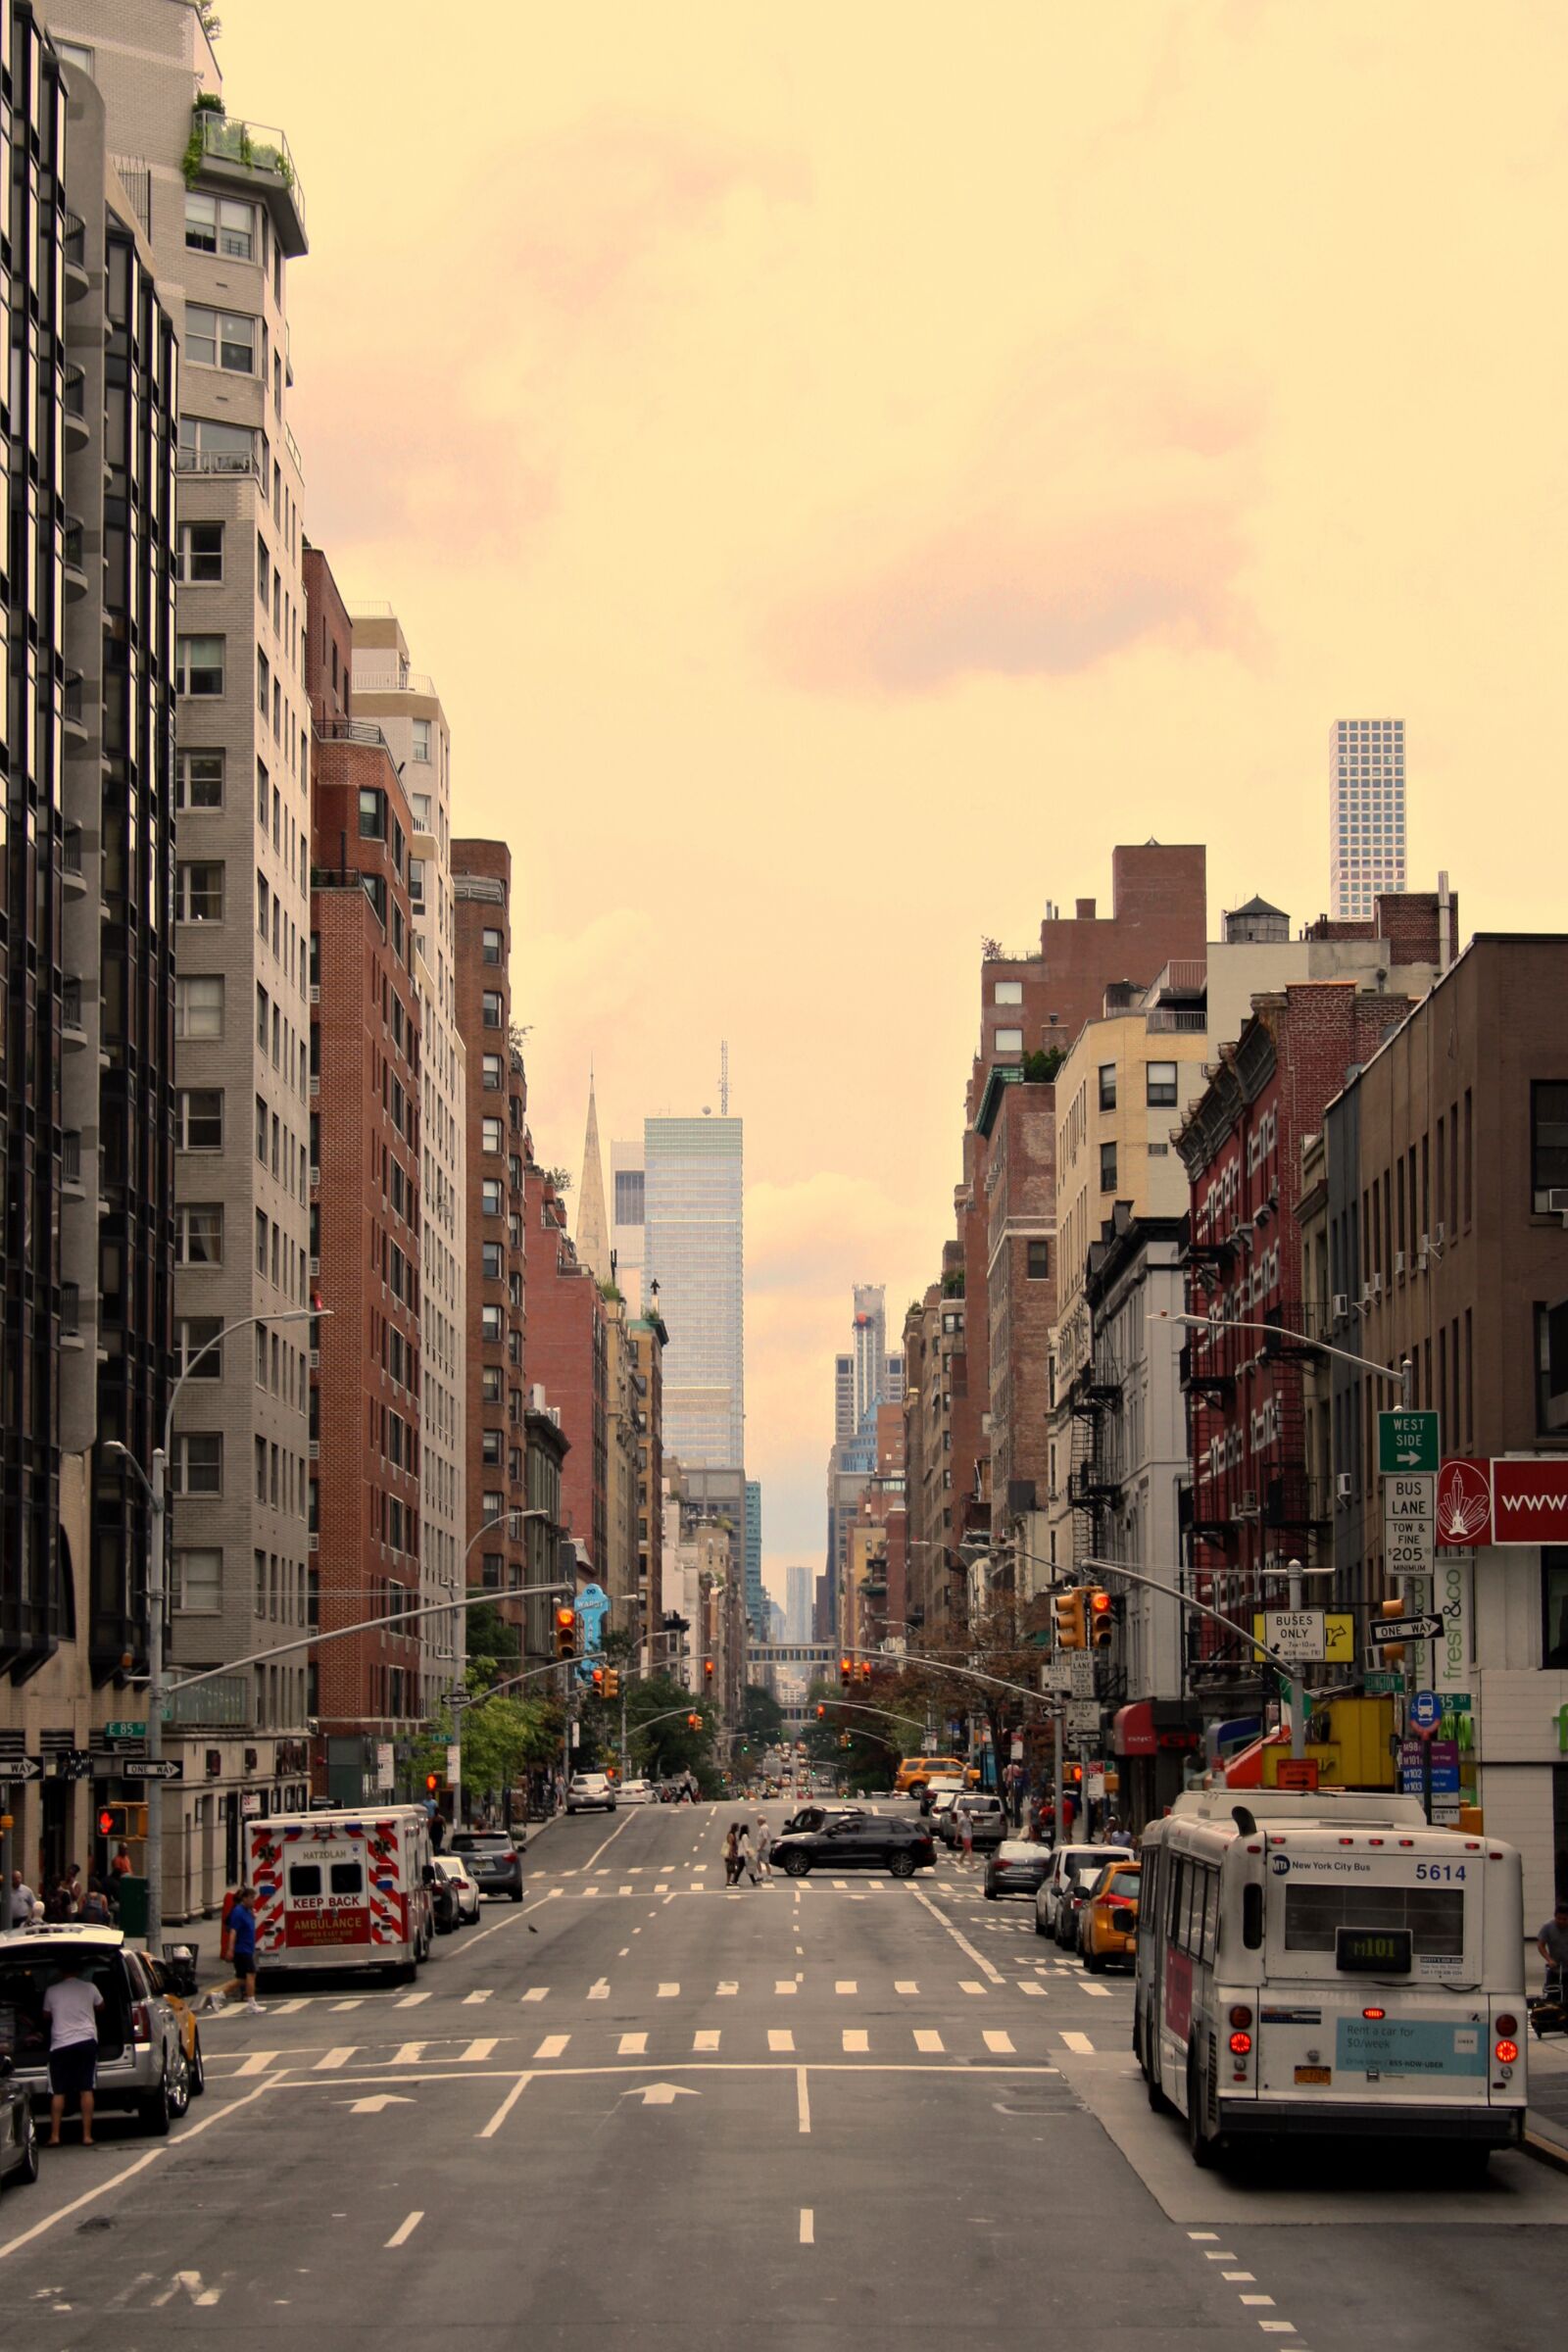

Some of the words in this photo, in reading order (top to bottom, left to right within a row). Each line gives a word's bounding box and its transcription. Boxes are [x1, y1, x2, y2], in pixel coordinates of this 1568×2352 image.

[1393, 1418, 1425, 1431] WEST
[1396, 1434, 1423, 1446] SIDE
[1396, 1482, 1422, 1495] BUS
[1392, 1500, 1426, 1514] LANE
[1392, 1523, 1413, 1533] TOW
[1418, 1523, 1426, 1533] &
[1397, 1535, 1420, 1544] FINE
[1276, 1615, 1313, 1626] BUSES
[1443, 1569, 1463, 1681] fresh&co
[1280, 1629, 1309, 1639] ONLY
[1380, 1626, 1402, 1637] ONE
[1410, 1622, 1432, 1634] WAY
[109, 1724, 116, 1735] E
[121, 1723, 135, 1735] 85
[11, 1763, 33, 1773] WAY
[131, 1764, 149, 1774] ONE
[157, 1763, 174, 1774] WAY
[1403, 1768, 1423, 1780] M102
[1403, 1781, 1423, 1792] M103
[1292, 1861, 1311, 1870] New
[1313, 1862, 1333, 1871] York
[1334, 1862, 1352, 1873] City
[1354, 1863, 1371, 1872] Bus
[1416, 1863, 1466, 1882] 5614
[293, 1897, 324, 1909] KEEP
[328, 1895, 360, 1907] BACK
[294, 1917, 362, 1931] AMBULANCE
[1348, 2025, 1369, 2035] Rent
[1372, 2028, 1379, 2036] a
[1381, 2028, 1396, 2036] car
[1399, 2027, 1414, 2037] for
